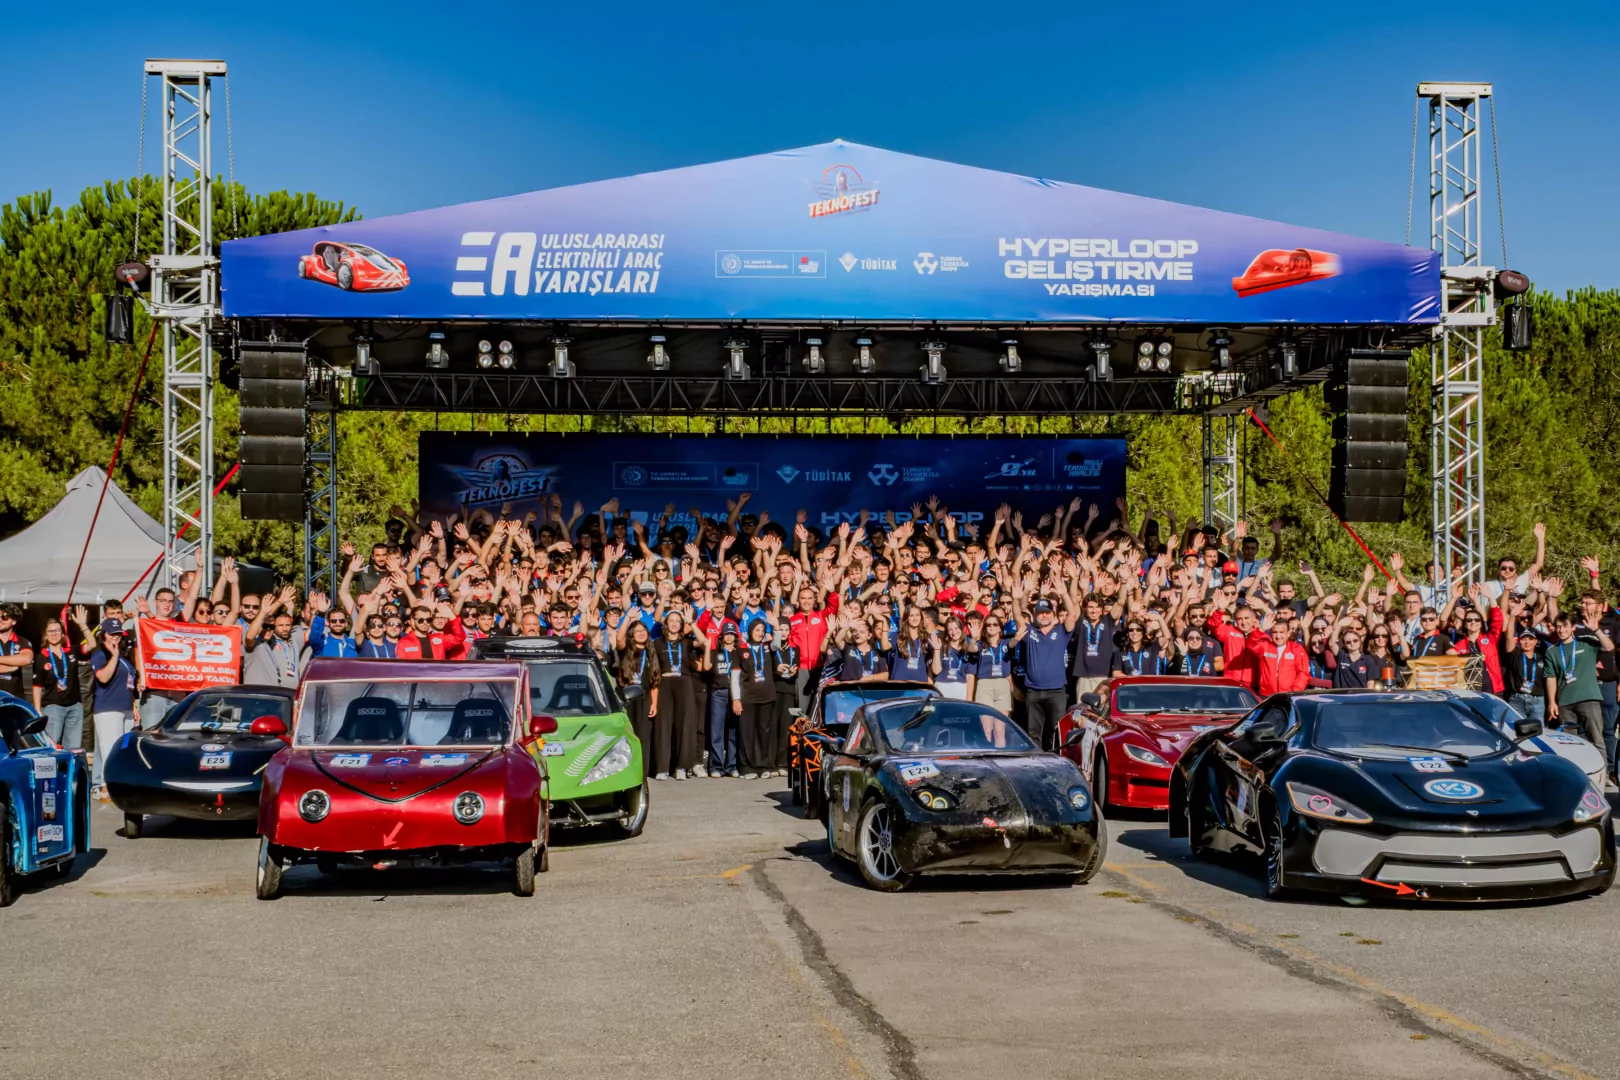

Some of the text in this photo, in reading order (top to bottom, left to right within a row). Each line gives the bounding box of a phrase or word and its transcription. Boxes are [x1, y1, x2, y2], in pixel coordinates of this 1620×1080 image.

[808, 189, 880, 218] TEKNOFEST
[541, 233, 665, 249] ULUSLARARASI
[998, 237, 1199, 259] HYPERLOOP
[536, 249, 664, 271] ELEKTRİKLİ ARAÇ
[534, 270, 660, 296] YARIŞLARI
[1043, 283, 1155, 297] YARIŞMASI
[805, 469, 852, 482] TÜBİTAK
[459, 476, 550, 504] TEKNOFEST
[144, 662, 200, 673] SAKARYA
[908, 766, 930, 776] E29
